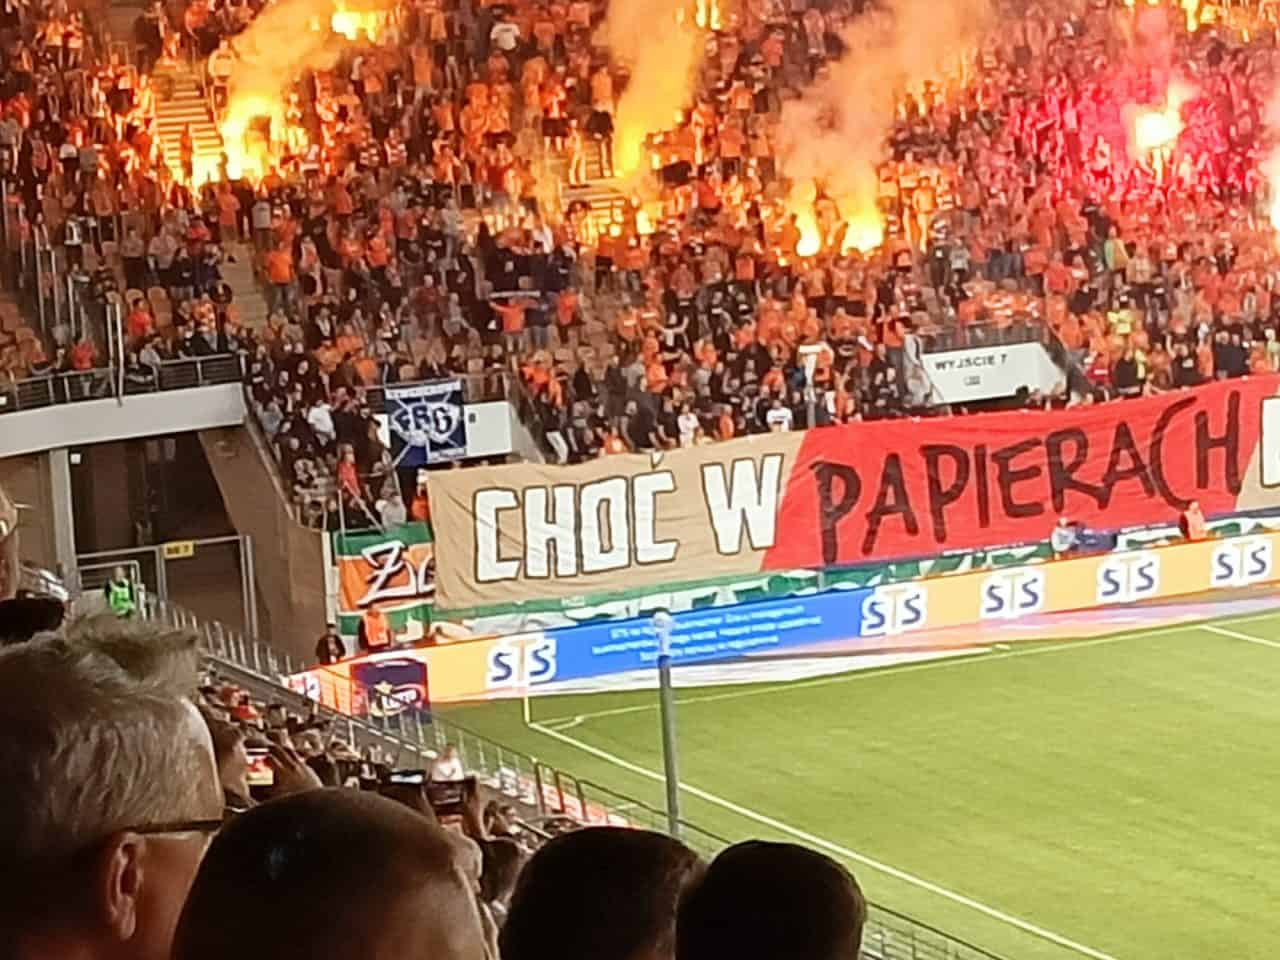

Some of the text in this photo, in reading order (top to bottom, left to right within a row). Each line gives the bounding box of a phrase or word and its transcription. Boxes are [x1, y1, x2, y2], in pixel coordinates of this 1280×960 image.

[473, 451, 680, 583] CHOĆ
[699, 451, 785, 556] W
[810, 390, 1242, 564] PAPIERACH
